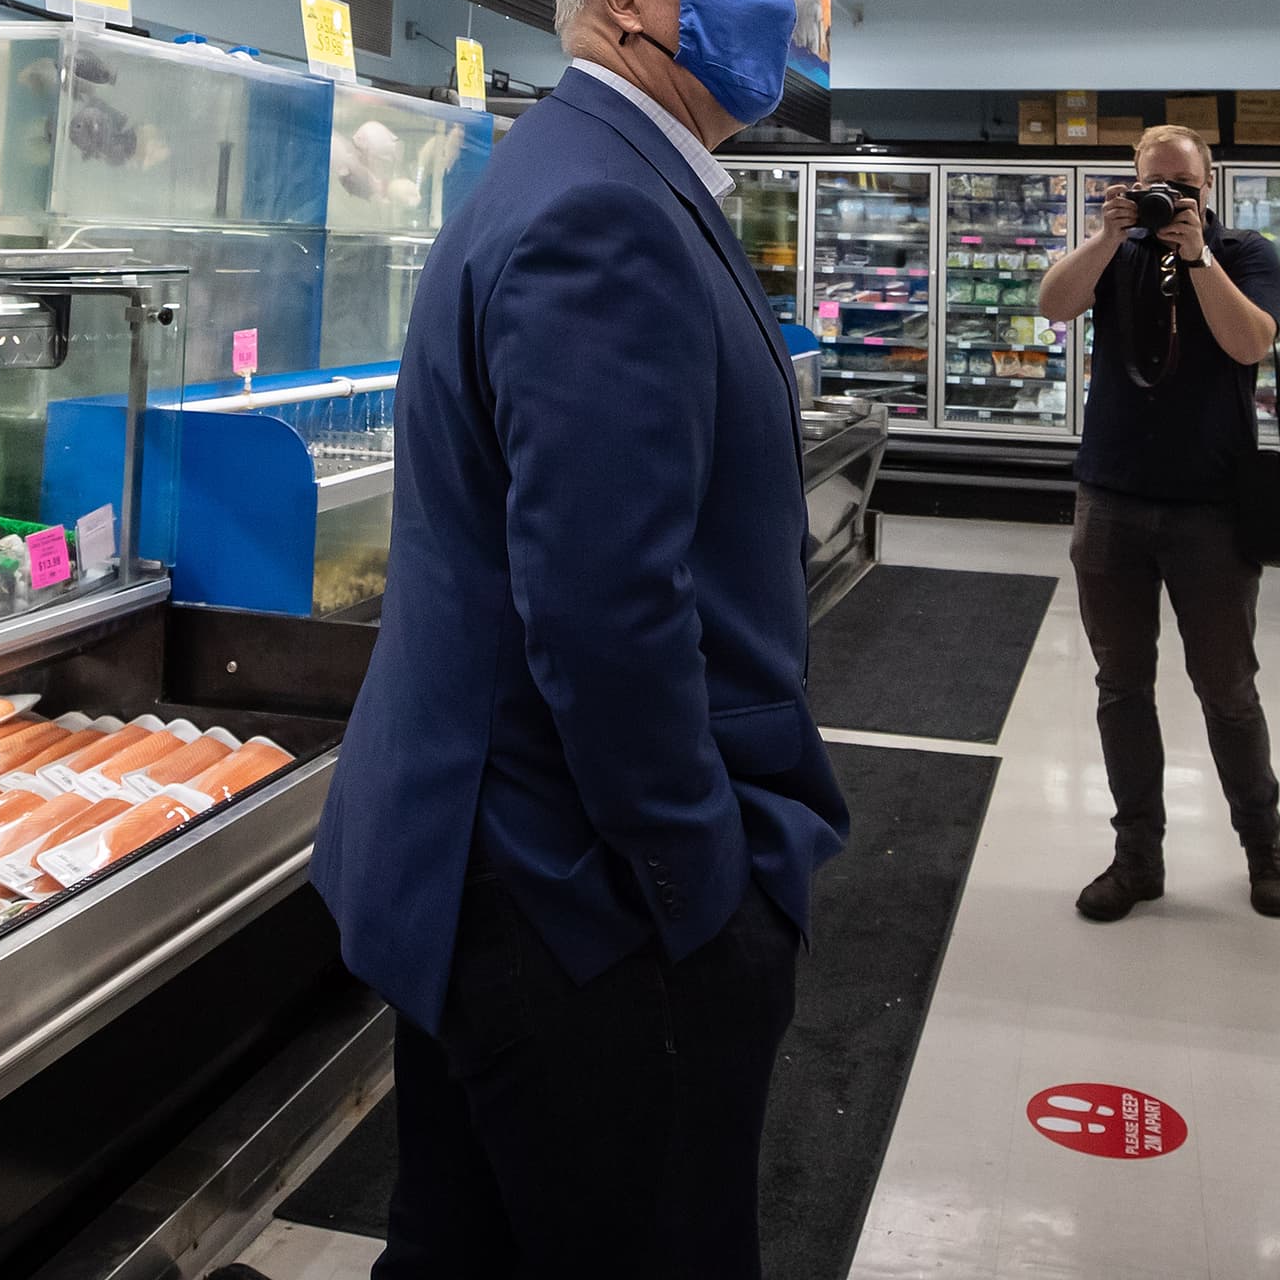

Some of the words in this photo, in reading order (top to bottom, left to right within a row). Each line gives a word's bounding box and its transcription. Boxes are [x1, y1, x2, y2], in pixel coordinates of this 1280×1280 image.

[1122, 1092, 1139, 1121] KEEP
[1143, 1098, 1163, 1134] APART
[1125, 1121, 1139, 1155] PLEASE
